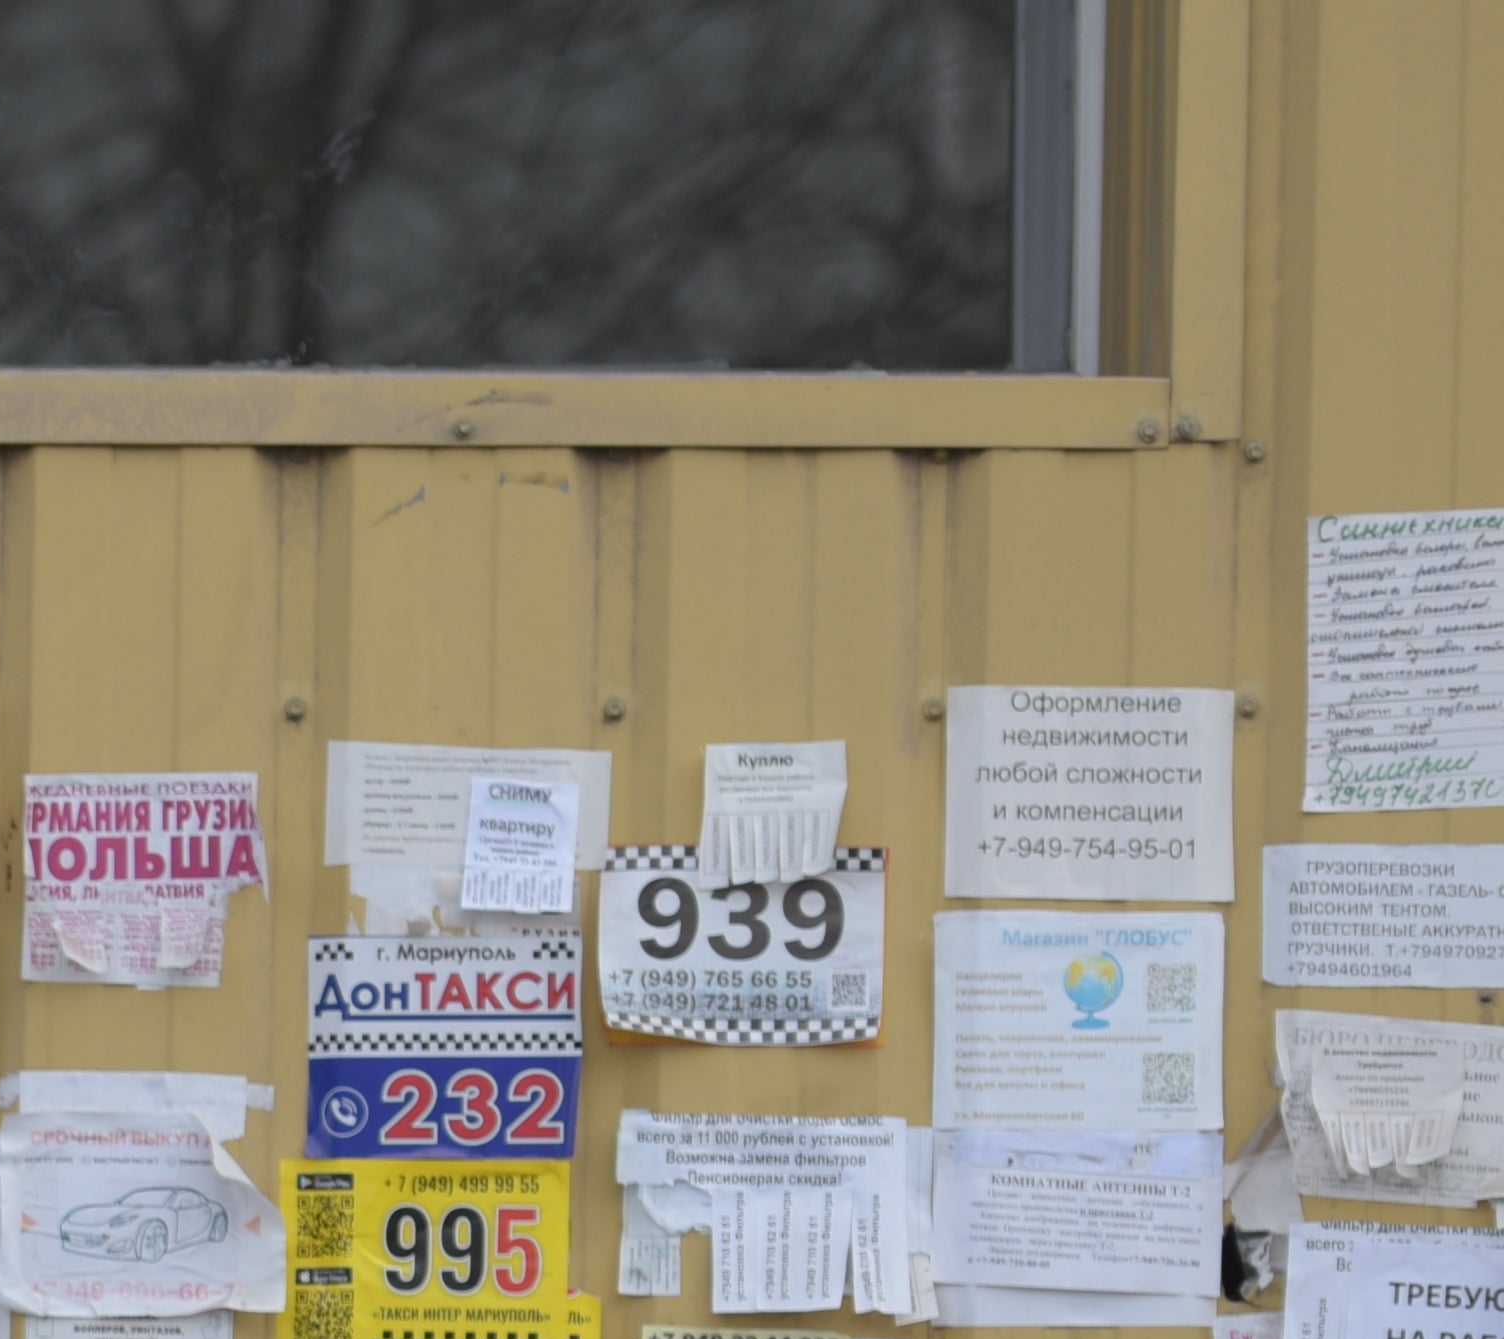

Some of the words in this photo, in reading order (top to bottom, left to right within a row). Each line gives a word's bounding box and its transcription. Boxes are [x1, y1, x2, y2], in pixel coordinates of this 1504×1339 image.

[1010, 691, 1181, 717] Оформление
[1001, 729, 1189, 749] недвижимости
[737, 752, 794, 771] Куплю
[976, 764, 1057, 786] любой
[1066, 766, 1202, 785] сложности
[488, 784, 552, 804] СНИМУ
[993, 805, 1006, 821] и
[1016, 803, 1184, 825] компенсации
[479, 819, 555, 839] квартиру
[978, 836, 1197, 860] +7-949-754-95-01
[1306, 861, 1456, 877] ГРУЗОПЕРЕВОЗКИ
[1288, 880, 1414, 897] АВТОМОБИЛЕМ
[637, 877, 846, 962] 939
[1289, 901, 1374, 917] ВЫСОКИМ
[1382, 902, 1451, 918] ТЕНТОМ.
[1001, 929, 1087, 947] Магазин
[1094, 927, 1192, 948] "ГЛОБУС"
[376, 945, 388, 960] г.
[396, 942, 515, 964] Мариуполь
[1288, 942, 1375, 959] ГРУЗЧИКИ.
[315, 971, 575, 1017] ДонТАКСИ
[380, 1069, 565, 1145] 232
[411, 1174, 454, 1197] (949)
[460, 1175, 488, 1194] 499
[493, 1175, 517, 1194] 99
[520, 1175, 540, 1194] 55
[385, 1204, 540, 1295] 995
[372, 1306, 419, 1324] «ТАКСИ
[423, 1306, 462, 1323] ИНТЕР
[465, 1307, 552, 1326] МАРИУПОЛЬ»
